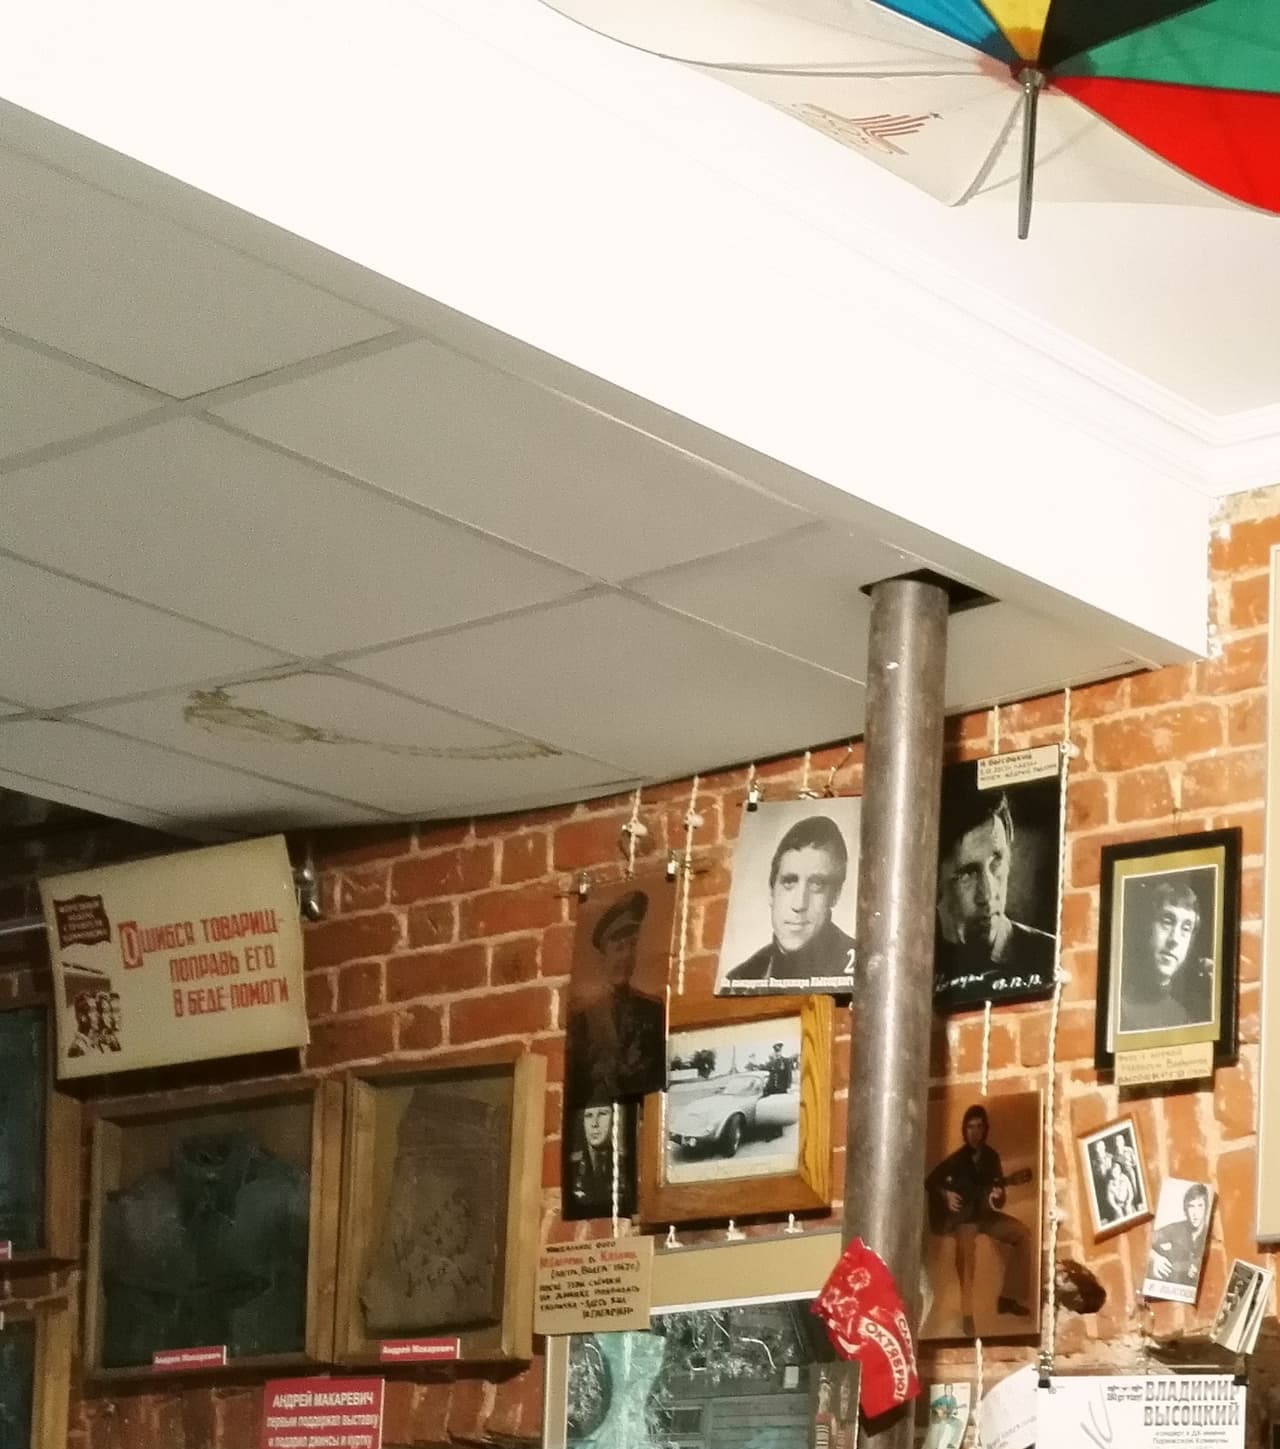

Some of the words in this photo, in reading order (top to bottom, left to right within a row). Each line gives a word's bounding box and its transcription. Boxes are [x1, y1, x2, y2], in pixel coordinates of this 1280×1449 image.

[118, 920, 195, 969] ОШИБСЯ
[169, 951, 240, 983] ПОПРАВЬ
[245, 945, 275, 971] ЕГО
[173, 989, 183, 1017] В
[273, 1390, 312, 1408] АНДРЕЙ
[314, 1391, 374, 1407] МАКАРЕВИЧ
[1145, 1380, 1240, 1402] ВЛАДИМИР
[298, 1415, 341, 1428] поддержал
[343, 1414, 378, 1428] выставку
[1143, 1402, 1240, 1427] ВЫСОЦКИЙ
[274, 1436, 307, 1448] подарил
[309, 1435, 340, 1447] джинсы
[349, 1435, 373, 1449] куртку
